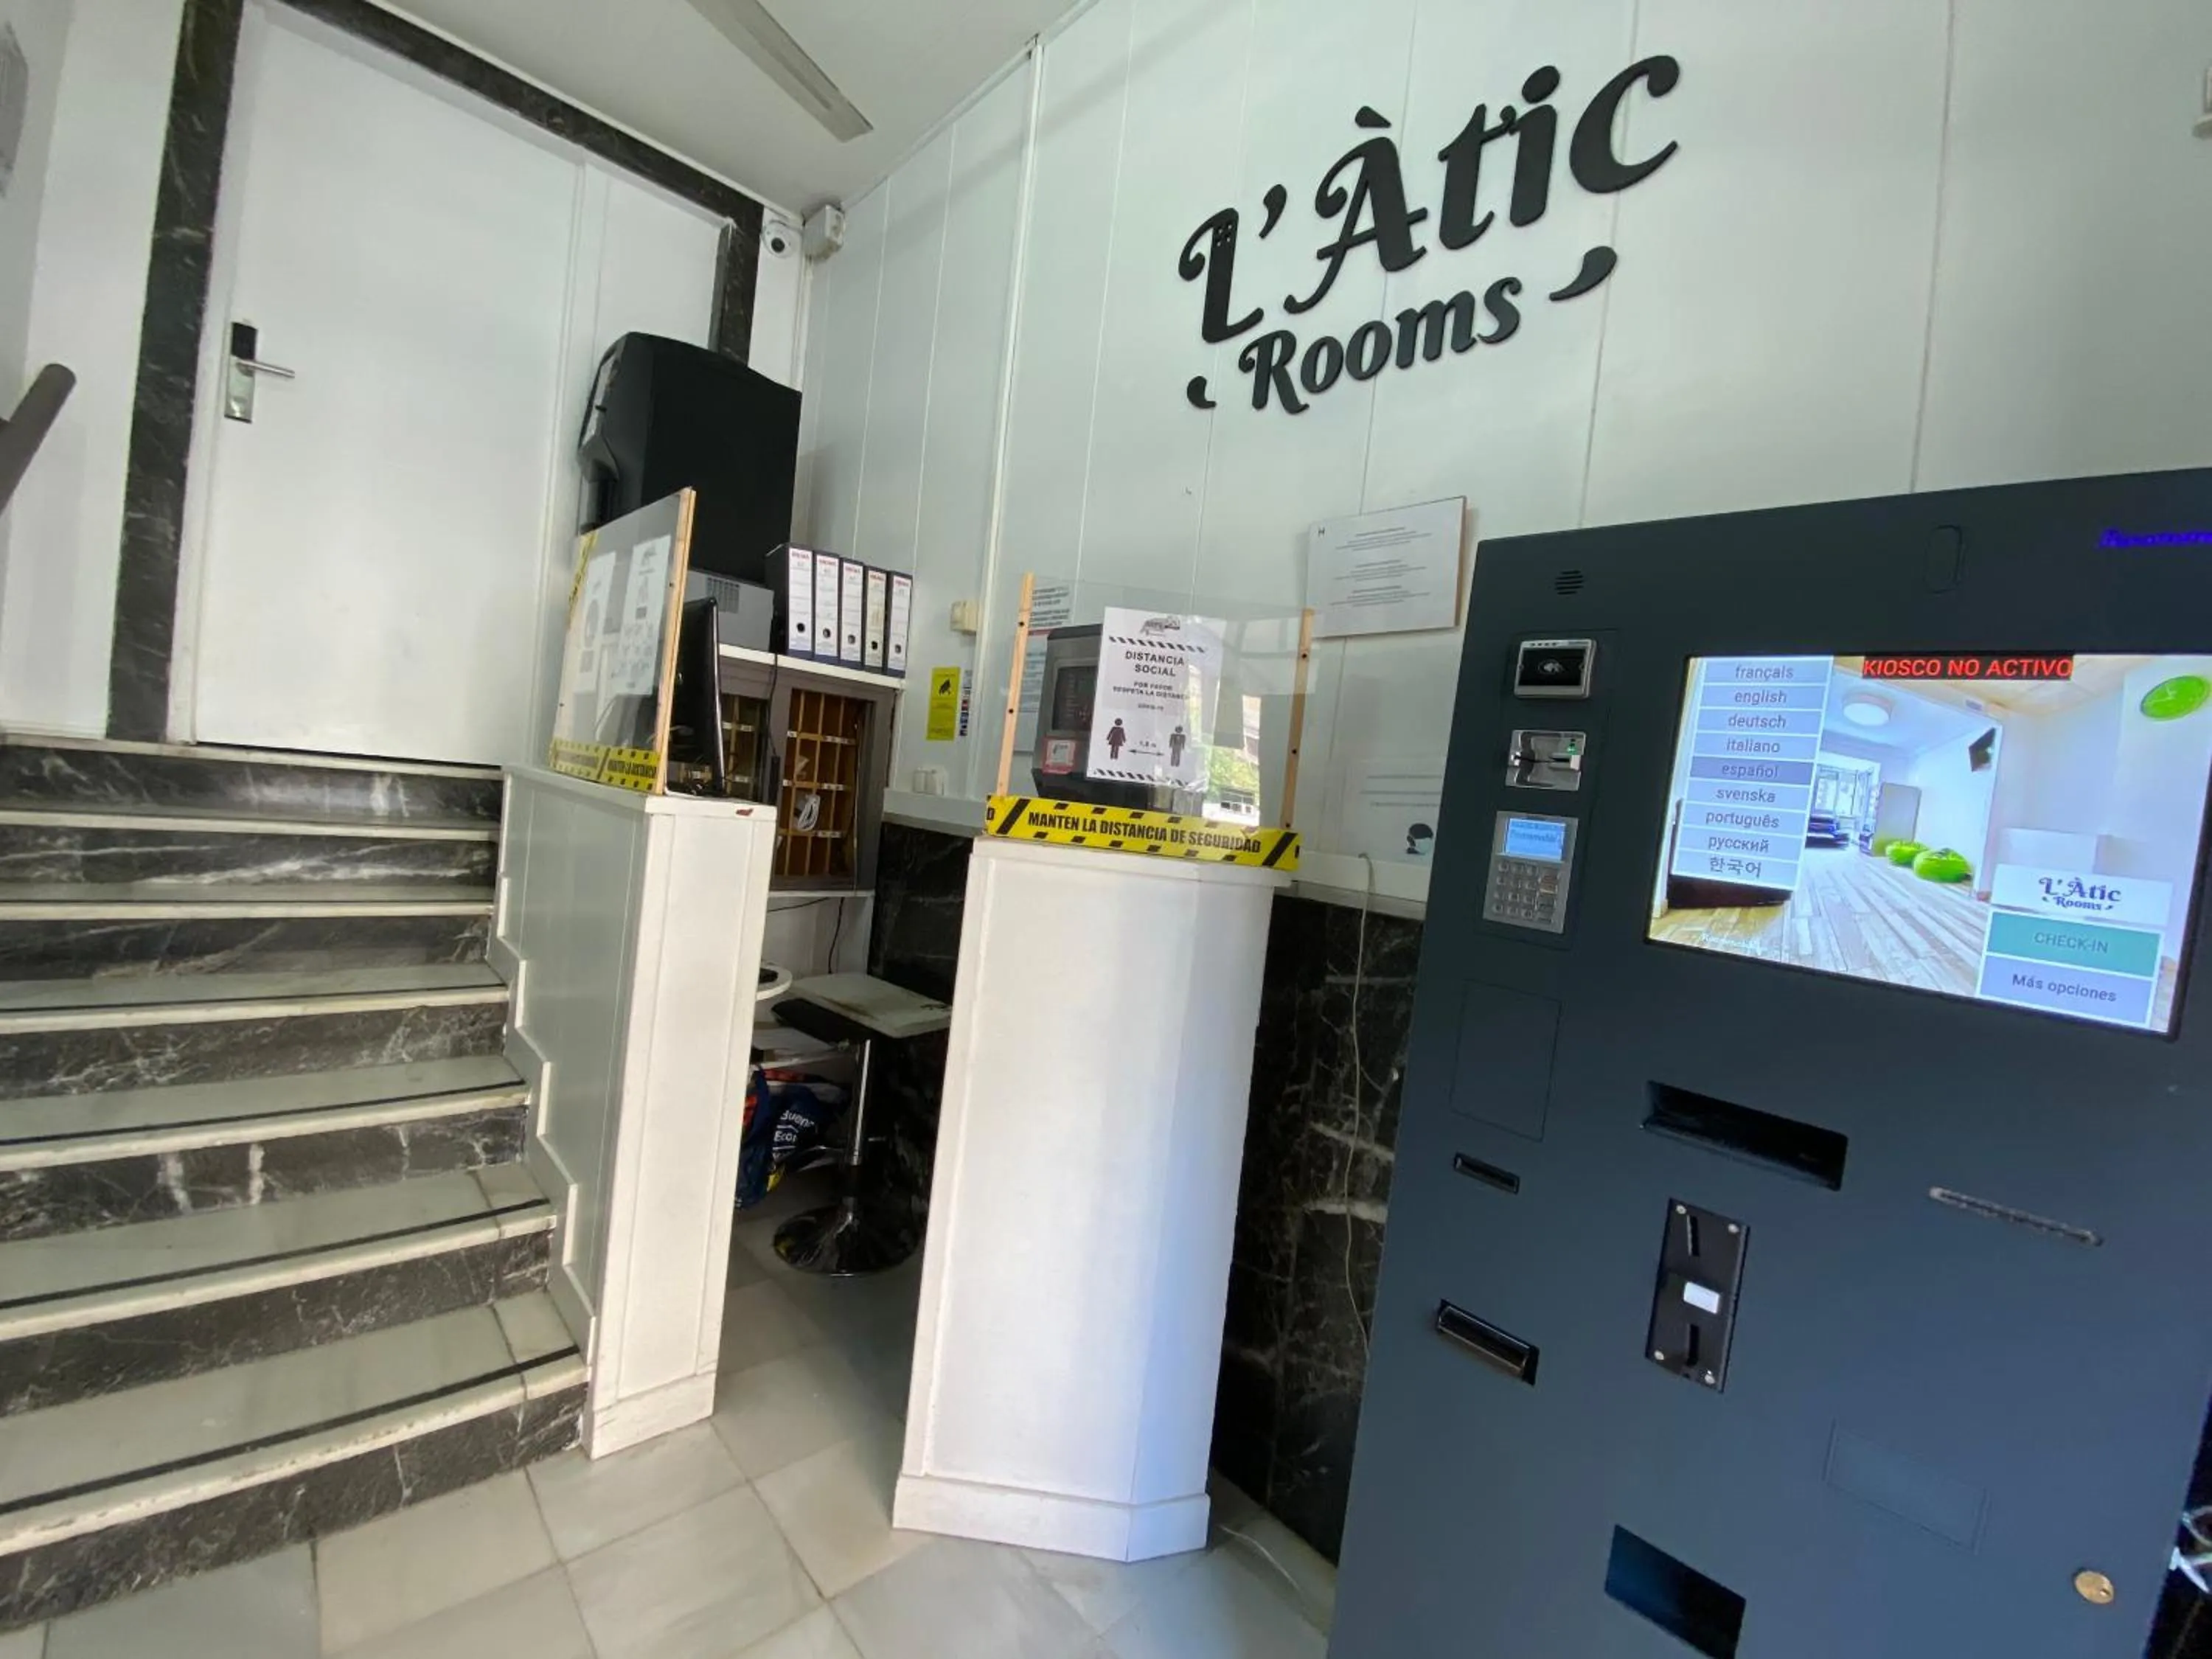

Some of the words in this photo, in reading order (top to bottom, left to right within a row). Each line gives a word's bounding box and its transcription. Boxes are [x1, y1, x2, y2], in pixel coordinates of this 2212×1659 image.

[1179, 55, 1680, 344] L'Àtic
[1238, 276, 1523, 414] Rooms
[1125, 650, 1184, 666] DISTANCIA
[1135, 664, 1176, 677] SOCIAL
[1735, 665, 1794, 681] français
[1863, 659, 1941, 676] KIOSCO
[1947, 659, 1980, 676] NO
[1985, 659, 2073, 676] ACTIVO
[1734, 689, 1787, 706] english
[1728, 714, 1787, 729] deutsch
[1726, 737, 1781, 753] italiano
[1722, 765, 1778, 779] español
[1716, 788, 1776, 804] svenska
[1705, 812, 1780, 828] português
[1028, 812, 1079, 831] MANTEN
[1082, 818, 1096, 833] LA
[1099, 820, 1167, 841] DISTANCIA
[1170, 830, 1186, 844] DE
[1189, 831, 1262, 853] SEGURIDAD
[1708, 837, 1770, 853] русский
[1710, 857, 1761, 878] 한국어
[2039, 877, 2121, 902] L'Àtic
[2053, 896, 2102, 911] Rooms
[2034, 932, 2109, 953] CHECK-IN
[2012, 973, 2043, 990] Más
[2048, 981, 2118, 1002] opciones
